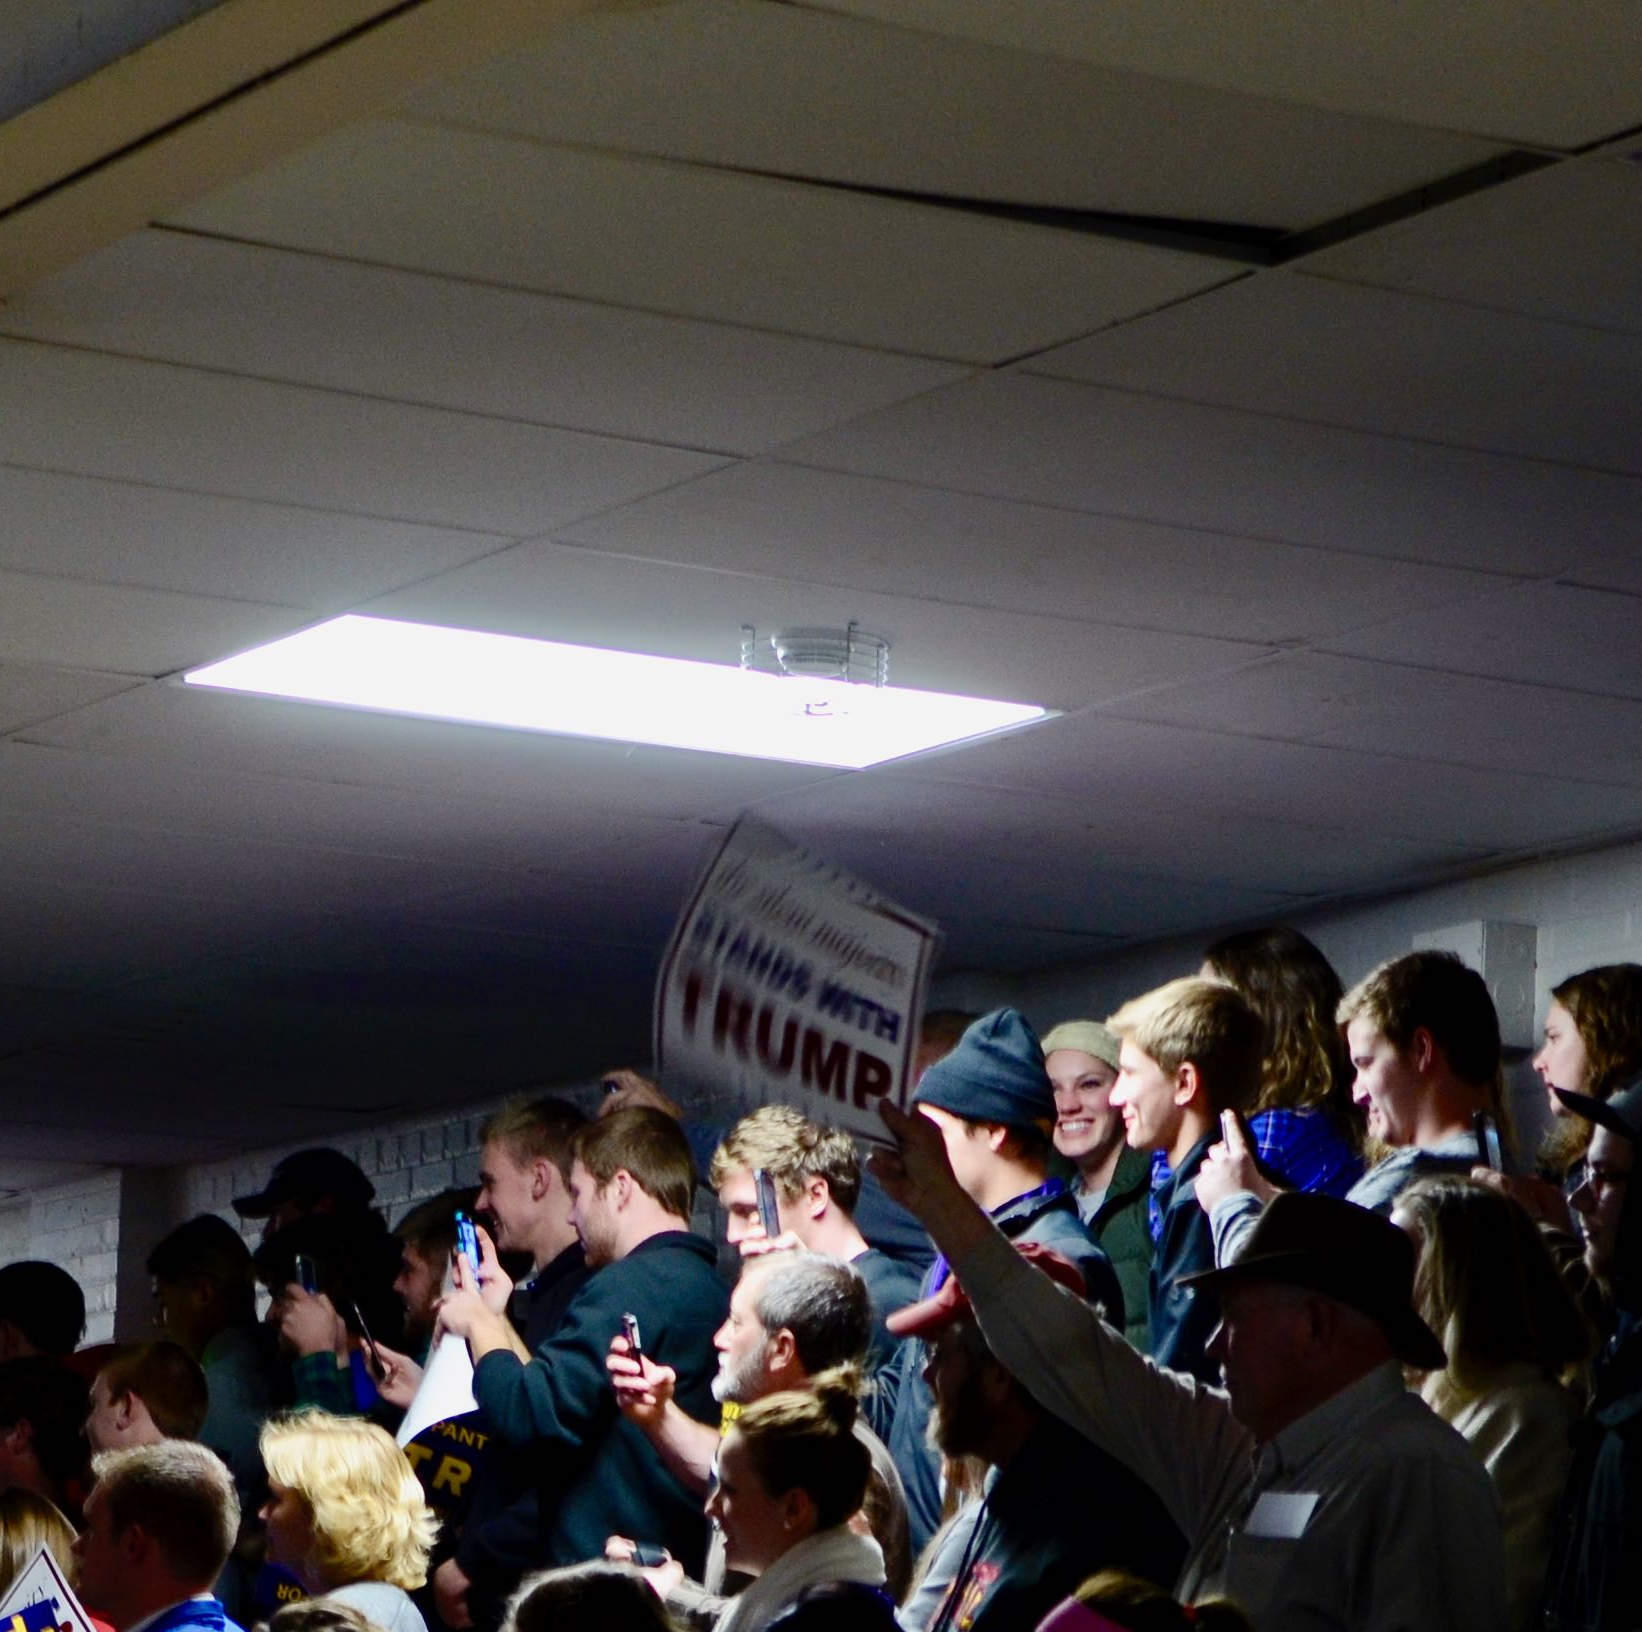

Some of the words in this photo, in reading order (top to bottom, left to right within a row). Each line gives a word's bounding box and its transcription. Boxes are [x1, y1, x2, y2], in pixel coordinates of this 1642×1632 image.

[681, 968, 891, 1110] TRUMP
[692, 905, 812, 999] STANDS
[816, 978, 900, 1044] WITH
